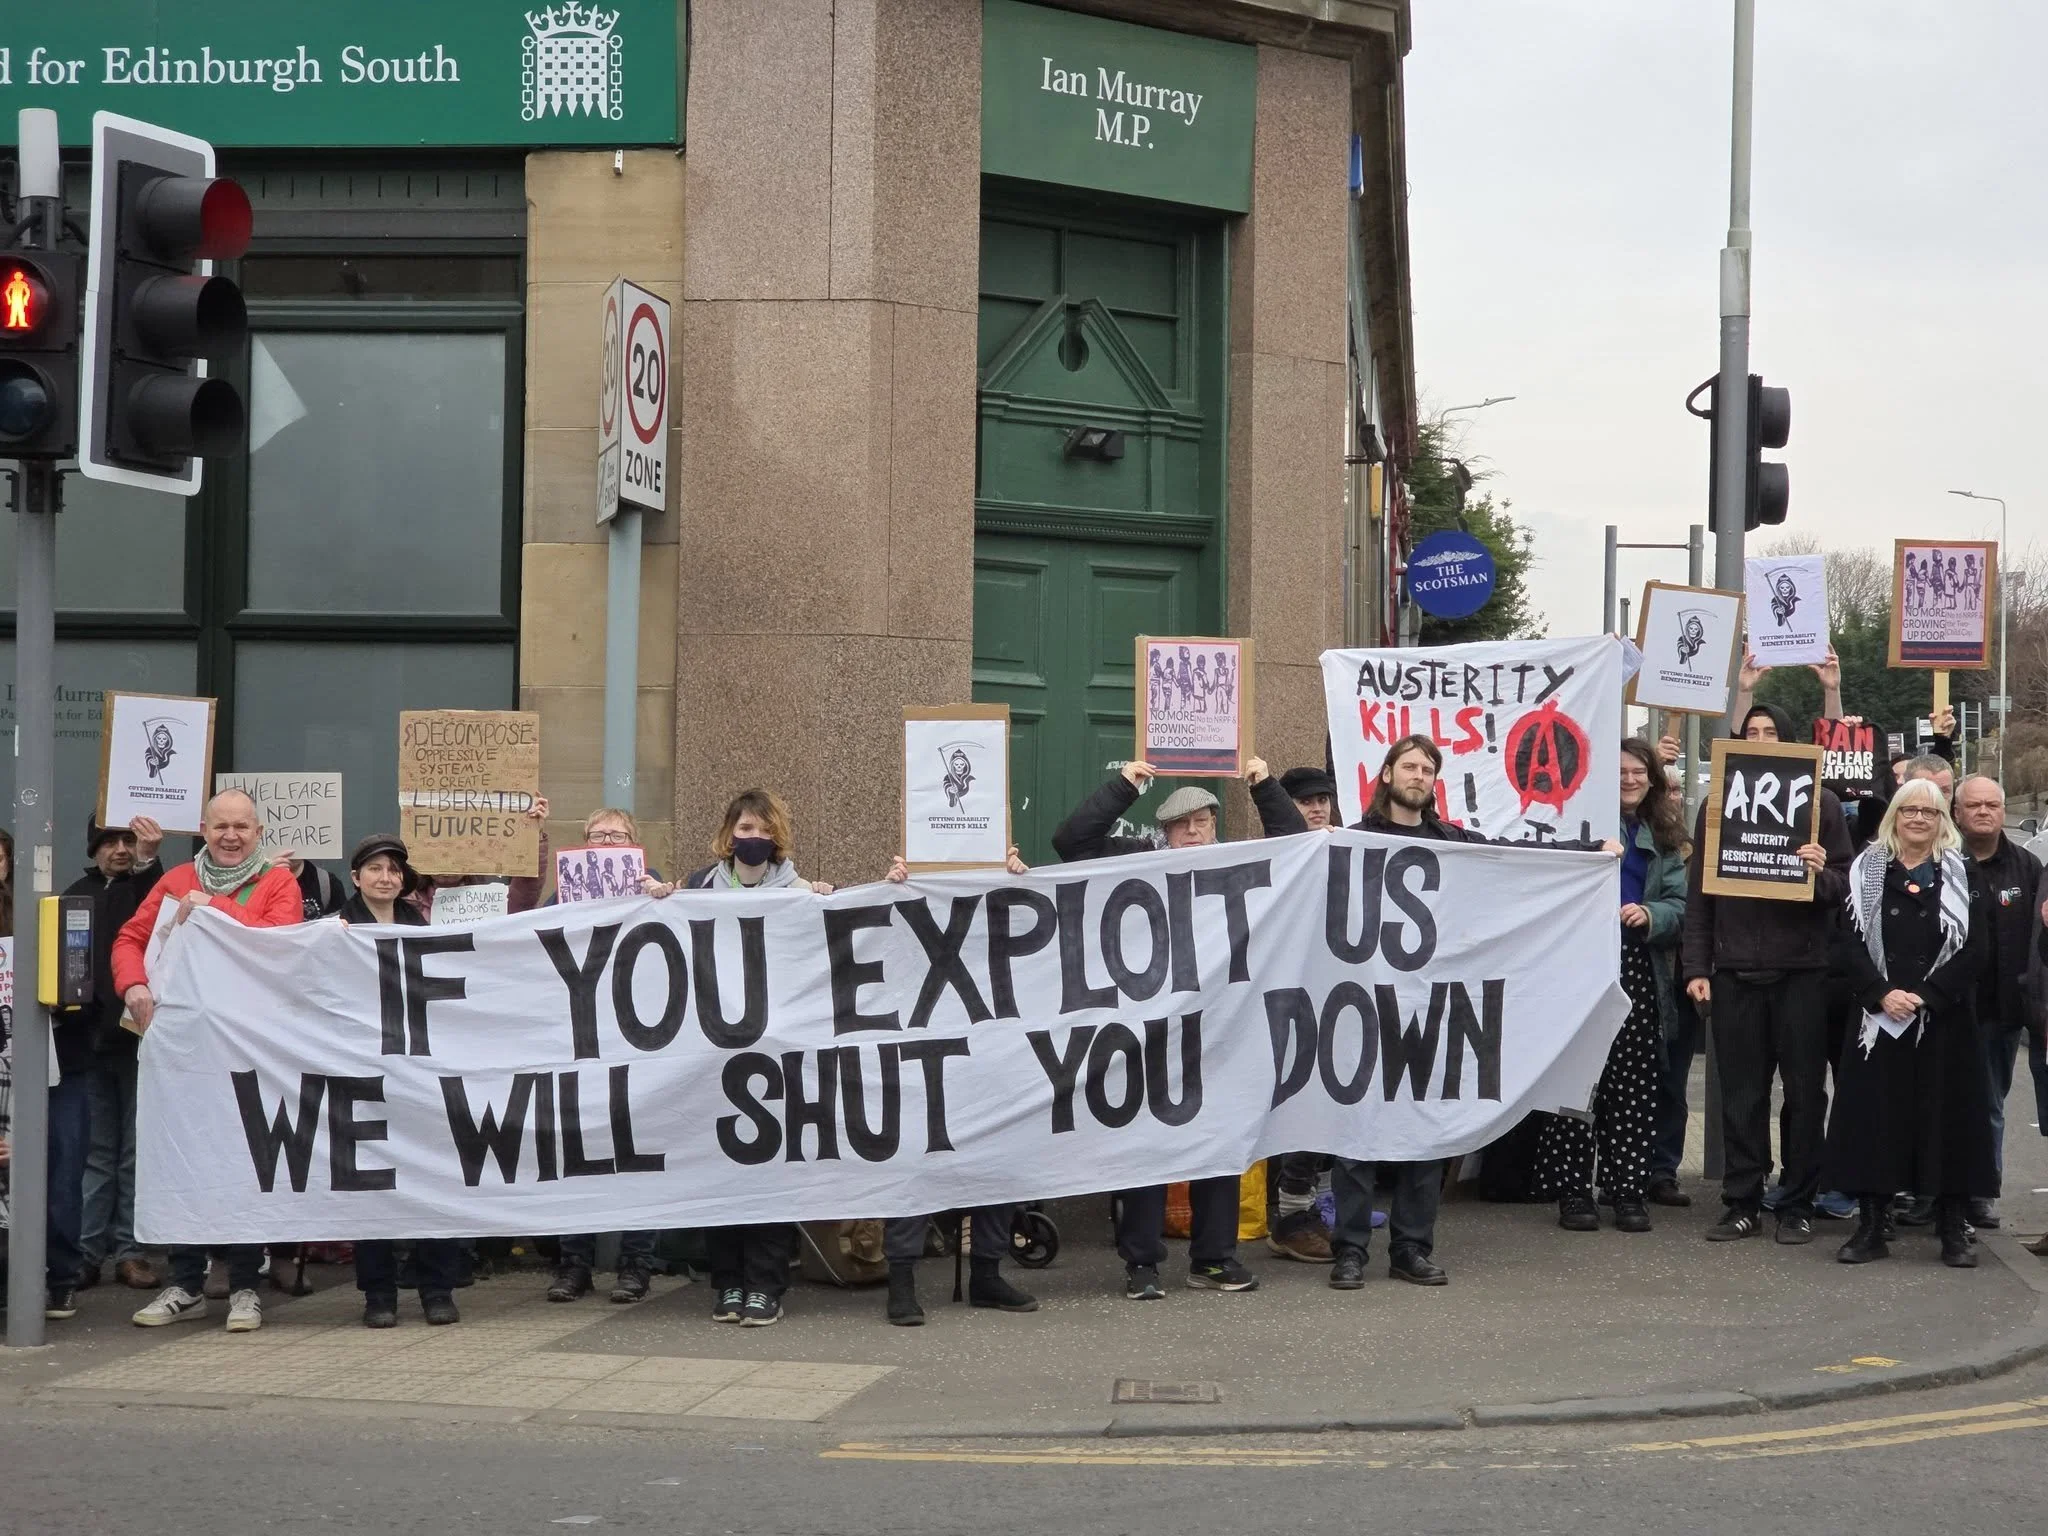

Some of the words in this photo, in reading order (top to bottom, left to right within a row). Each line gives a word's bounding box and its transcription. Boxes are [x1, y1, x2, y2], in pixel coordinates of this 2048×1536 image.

[27, 46, 86, 84] for
[101, 44, 323, 93] Edinburgh
[340, 44, 461, 84] South
[1040, 56, 1088, 97] Ian
[1096, 67, 1203, 126] Murray
[1095, 107, 1154, 150] M.P.
[632, 342, 661, 405] 20
[625, 448, 662, 494] ZONE
[1435, 563, 1465, 577] THE
[1415, 572, 1488, 593] SCOTSMAN
[1905, 607, 1919, 617] NO
[1920, 607, 1946, 617] MORE
[1902, 619, 1946, 629] GROWING
[1907, 631, 1919, 640] UP
[1920, 631, 1946, 641] POOR
[1356, 658, 1576, 706] AUSTERITY
[1661, 676, 1692, 685] BENEFITS
[1150, 710, 1166, 721] NO
[1167, 710, 1195, 722] MORE
[413, 721, 535, 747] DECOMPOSE
[1147, 723, 1195, 735] GROWING
[1814, 717, 1874, 753] BAN
[1153, 736, 1166, 747] UP
[1167, 736, 1195, 748] POOR
[416, 748, 498, 763] OPPRESSIVE
[419, 762, 488, 776] SYSTEMS
[420, 776, 436, 788] TO
[439, 774, 492, 788] CREATE
[130, 792, 164, 800] BENEFITS
[165, 793, 185, 801] KILLS
[412, 788, 534, 814] LIBERATED
[1724, 769, 1813, 828] ARF
[266, 803, 318, 823] NOT
[413, 814, 517, 839] FUTURES
[1741, 832, 1790, 847] AUSTERITY
[1722, 849, 1776, 865] RESISTANCE
[465, 890, 504, 904] BALANCE
[458, 903, 489, 915] BOOKS
[374, 932, 475, 1057] IF
[535, 915, 769, 1060] YOU
[823, 858, 1271, 1037] EXPLOIT
[1325, 845, 1441, 972] US
[230, 1068, 397, 1194] WE
[438, 1064, 666, 1187] WILL
[715, 1036, 971, 1166] SHUT
[1025, 1009, 1204, 1135] YOU
[1263, 978, 1506, 1112] DOWN
